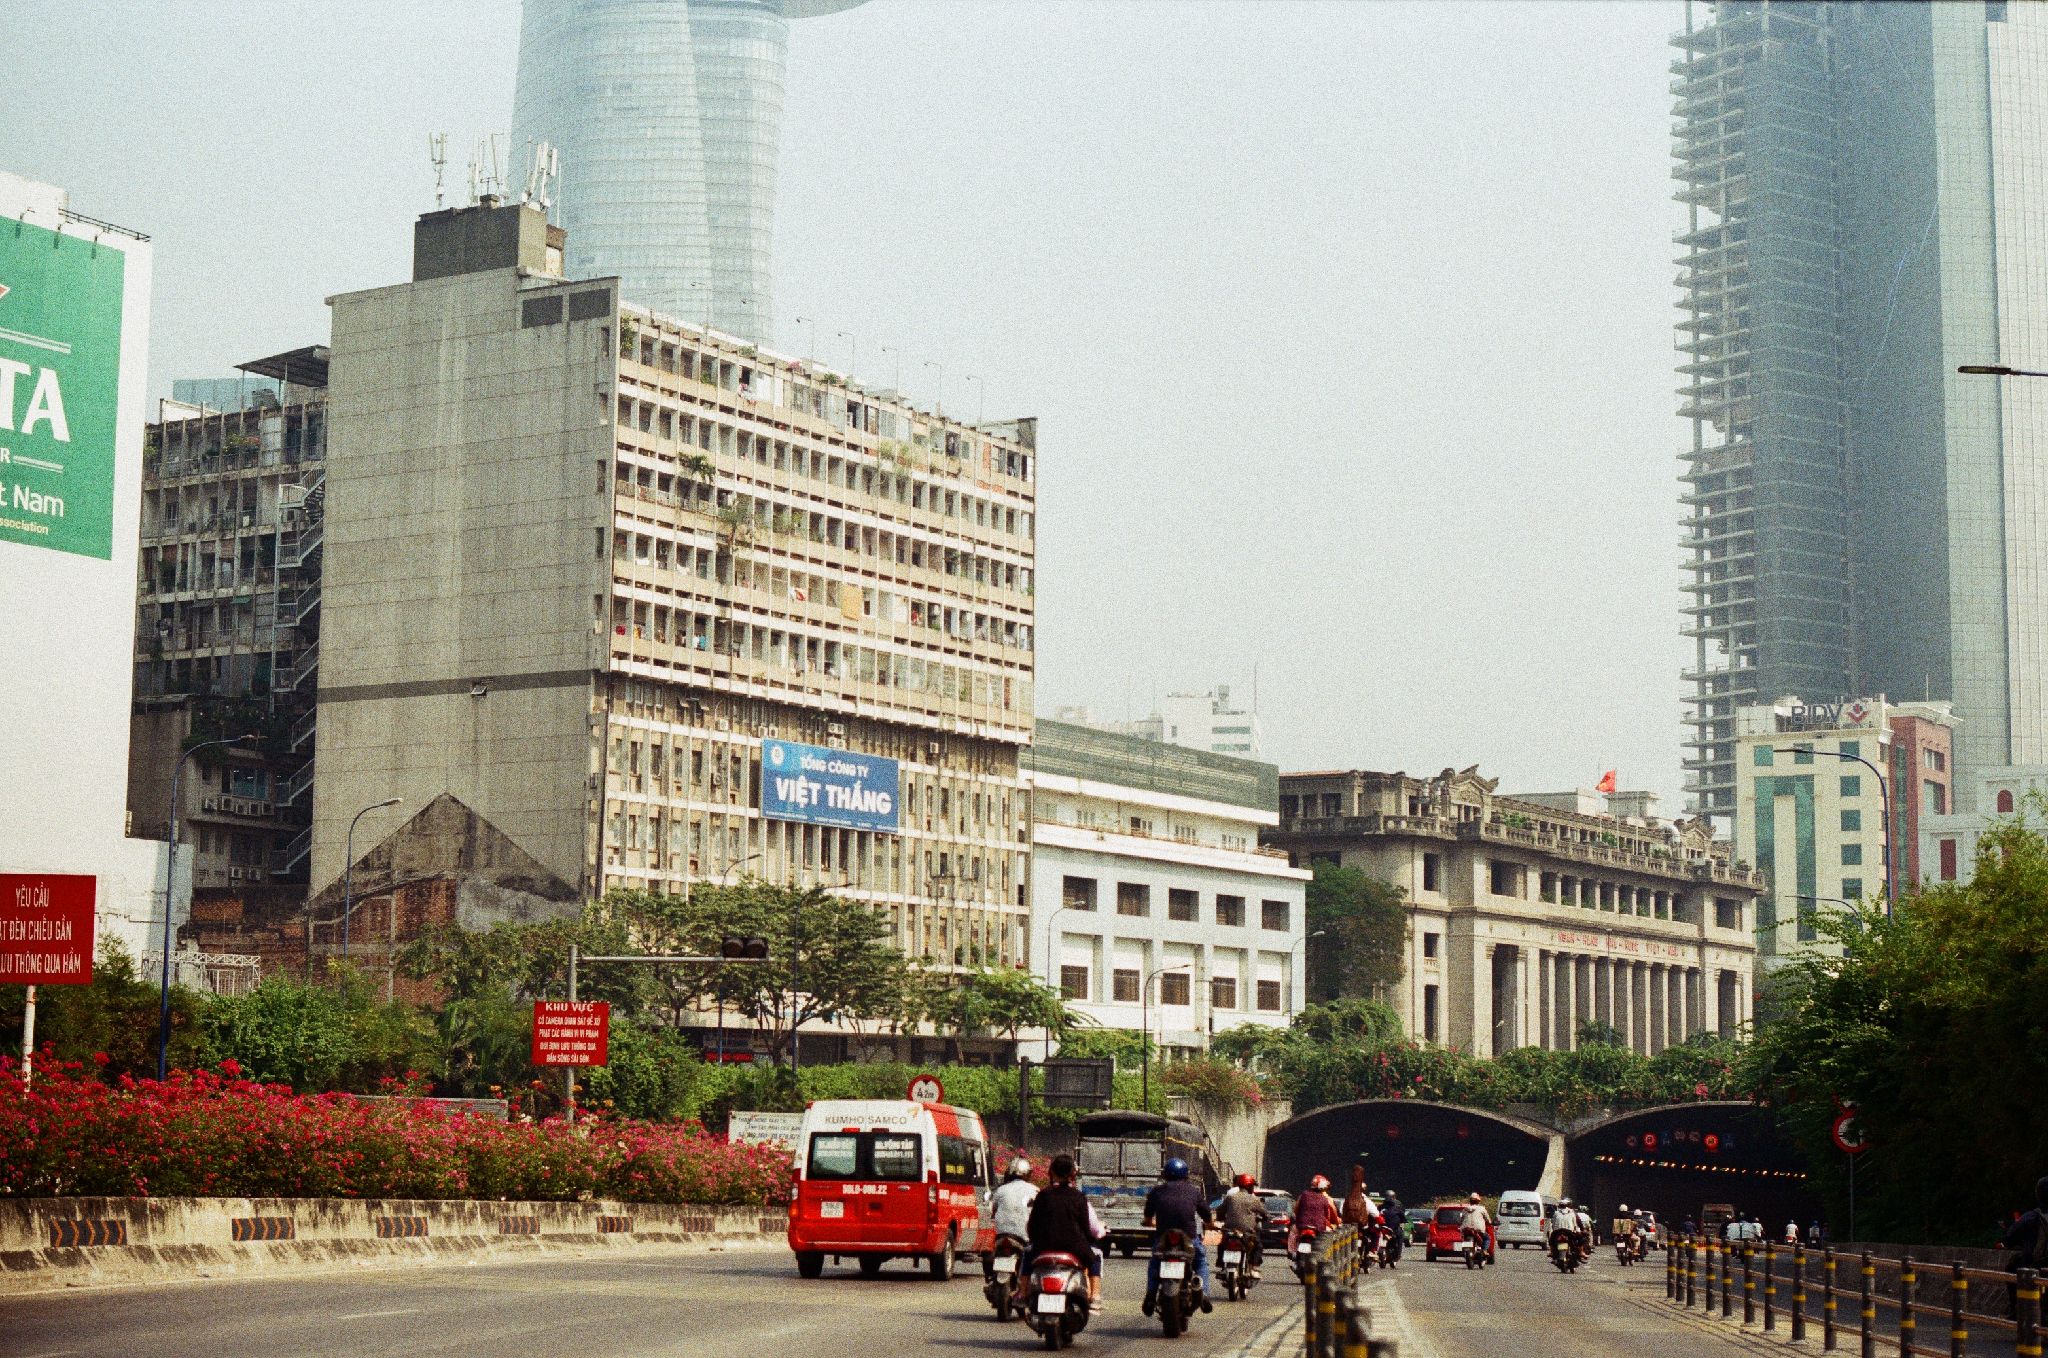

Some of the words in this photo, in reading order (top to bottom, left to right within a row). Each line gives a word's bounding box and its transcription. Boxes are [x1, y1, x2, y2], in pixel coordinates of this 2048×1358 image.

[14, 484, 64, 518] Nam
[1791, 703, 1843, 724] BIDV
[801, 753, 826, 772] TỔNG
[828, 760, 856, 777] CÔNG
[857, 765, 869, 778] TY
[776, 775, 821, 808] VIỆT
[825, 780, 892, 815] THẮNG
[15, 883, 31, 907] YÊU
[33, 881, 50, 907] CẦU
[9, 915, 26, 940] ĐÈN
[28, 913, 53, 940] CHIẾU
[55, 913, 72, 940] GẦN
[15, 950, 43, 973] THÔNG
[44, 953, 61, 973] QUA
[62, 946, 81, 973] HẦM
[545, 1003, 568, 1011] KHU
[571, 1002, 594, 1014] VỰC
[825, 1116, 864, 1125] KUMHO
[868, 1116, 907, 1125] SAMCO
